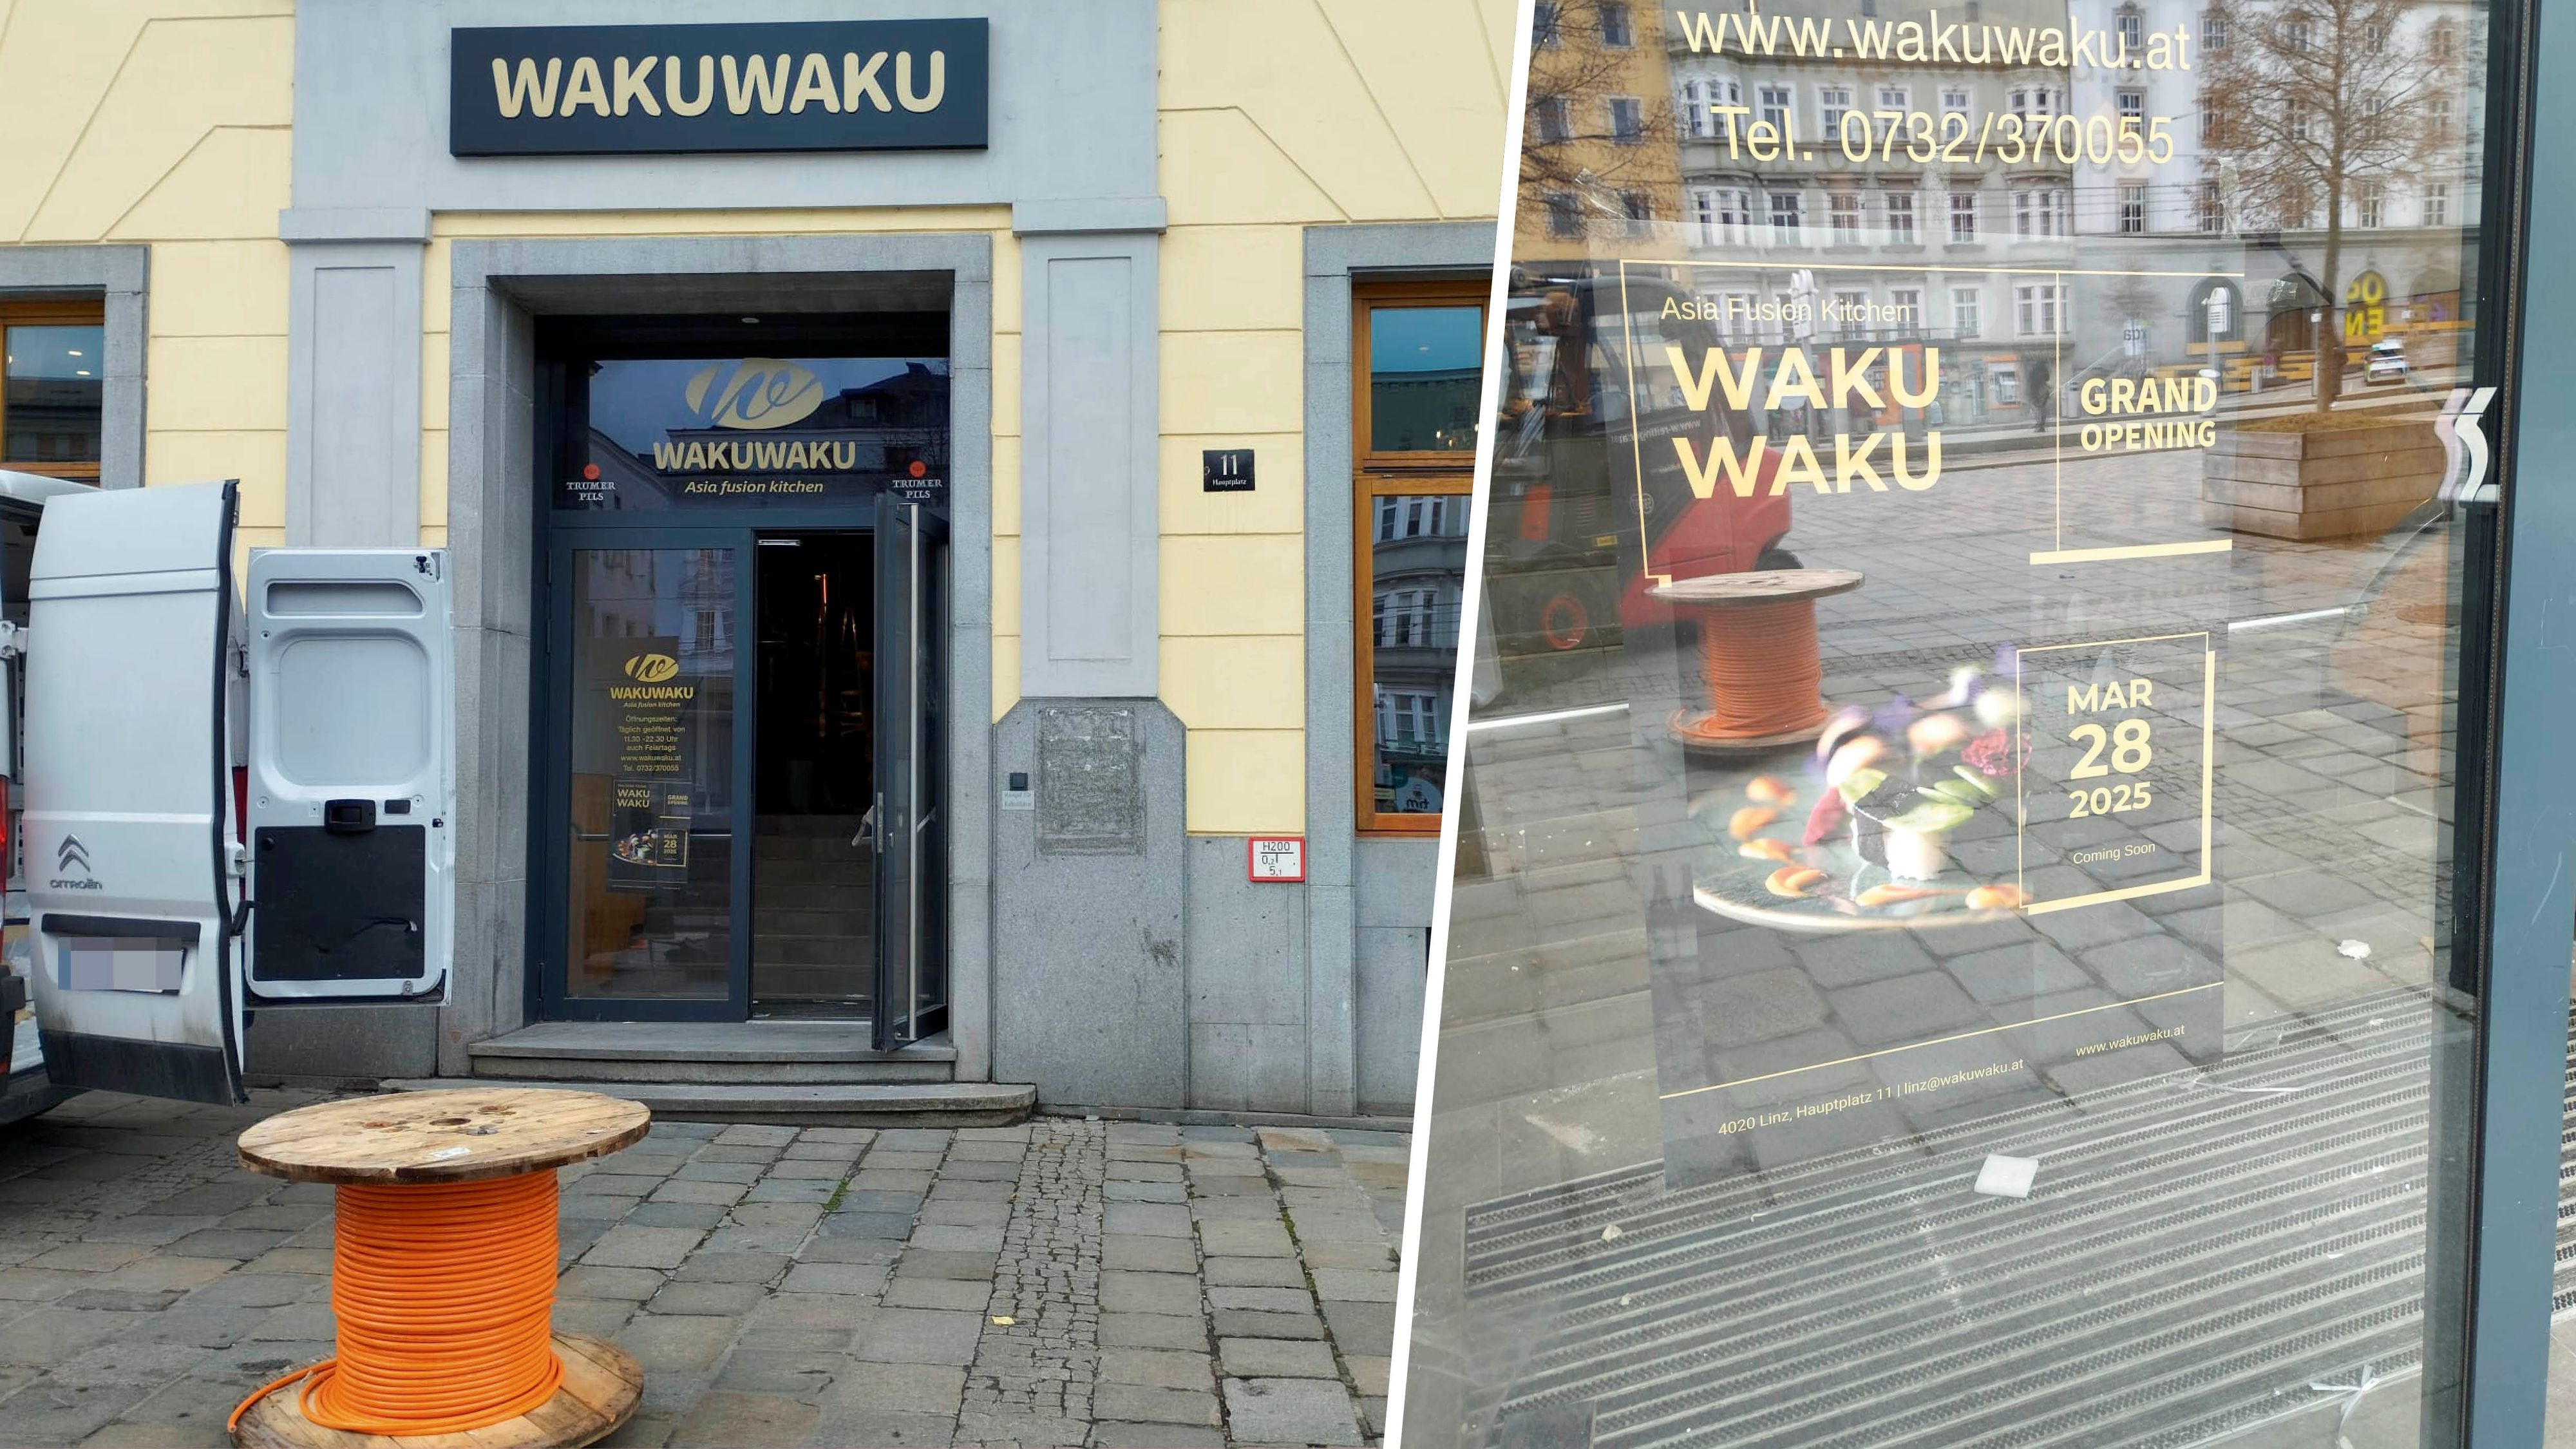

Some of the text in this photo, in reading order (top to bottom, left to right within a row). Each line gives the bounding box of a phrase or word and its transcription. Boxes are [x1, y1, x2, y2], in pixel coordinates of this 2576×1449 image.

[1676, 9, 2191, 71] www.wakuwaku.at
[492, 50, 945, 118] WAKUWAKU
[1710, 106, 2174, 165] Tel. 0732/370055
[1661, 296, 1911, 322] Asia Fusion Kitchen
[1666, 346, 1939, 412] WAKU
[2081, 377, 2217, 415] GRAND
[2081, 421, 2216, 451] OPENING
[653, 441, 856, 469] WAKUWAKU
[1220, 453, 1237, 475] 11
[1672, 431, 1942, 499] WAKU
[566, 482, 616, 490] TRUMER
[685, 480, 824, 495] Asia fusion kitchen
[892, 479, 943, 488] TRUMER
[905, 490, 931, 498] PILS
[1212, 478, 1247, 487] Hauptplatz
[578, 492, 604, 501] PILS
[611, 687, 694, 699] WAKUWAKU
[2068, 678, 2153, 715] MAR
[2068, 719, 2152, 780] 28
[617, 799, 650, 808] WAKU
[618, 789, 650, 798] WAKU
[2069, 781, 2152, 819] 2025
[663, 839, 677, 848] 28
[1263, 842, 1290, 851] H200
[2073, 843, 2155, 865] Coming Soon
[2076, 1025, 2185, 1057] www.wakuwaku.at
[1718, 1117, 1756, 1135] 4020
[1760, 1111, 1793, 1127] Linz,
[1797, 1092, 1872, 1119] Hauptplatz
[1877, 1086, 1891, 1101] 11
[1904, 1058, 2024, 1095] linz@wakuwaku.at
